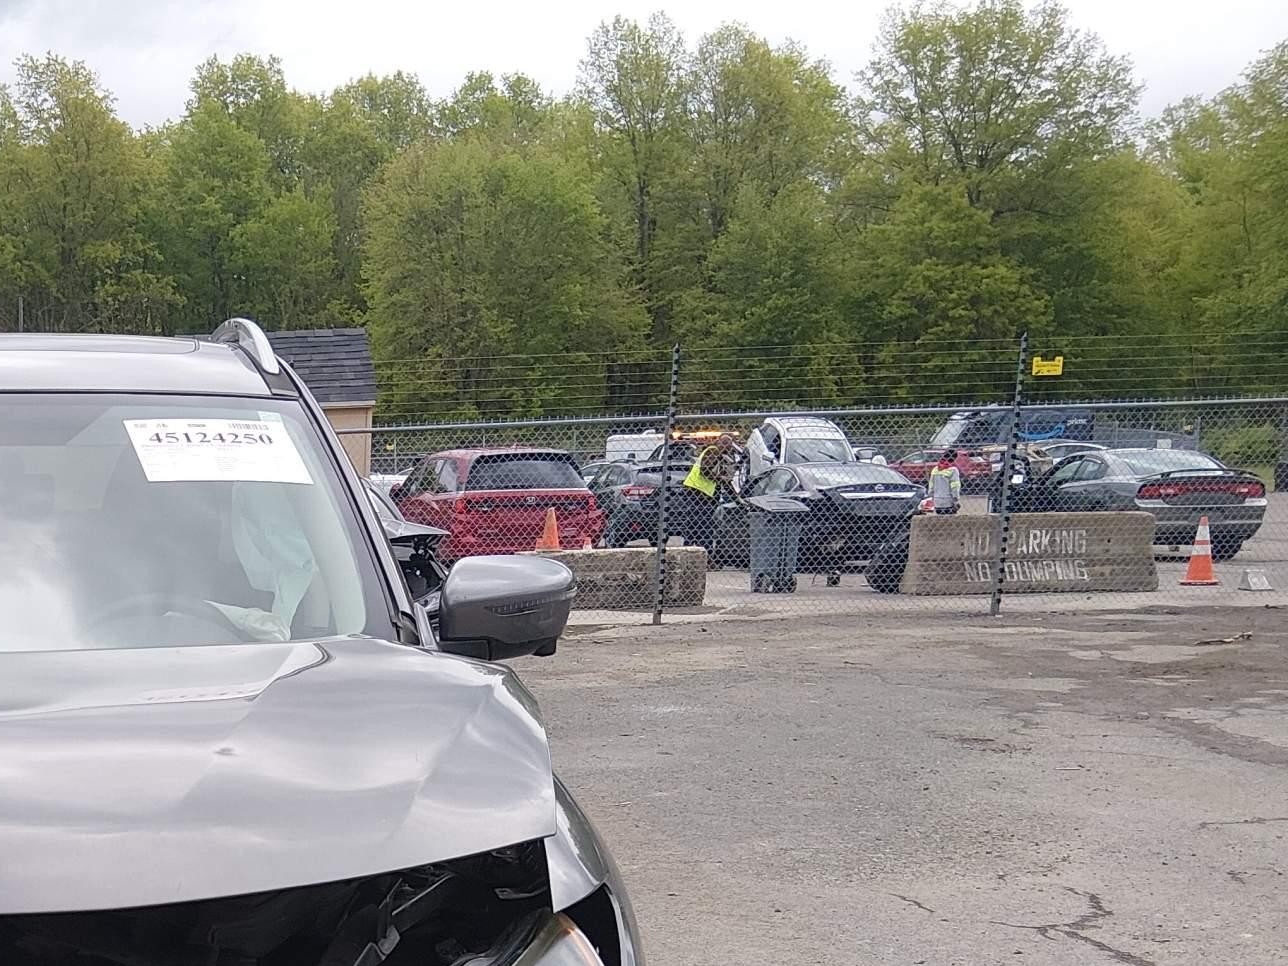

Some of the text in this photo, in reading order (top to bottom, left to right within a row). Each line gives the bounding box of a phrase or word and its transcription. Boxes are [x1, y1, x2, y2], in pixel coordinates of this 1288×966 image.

[149, 432, 273, 445] 45124250
[963, 529, 1087, 556] NO PARKING
[964, 559, 1089, 582] NO DUMPING
